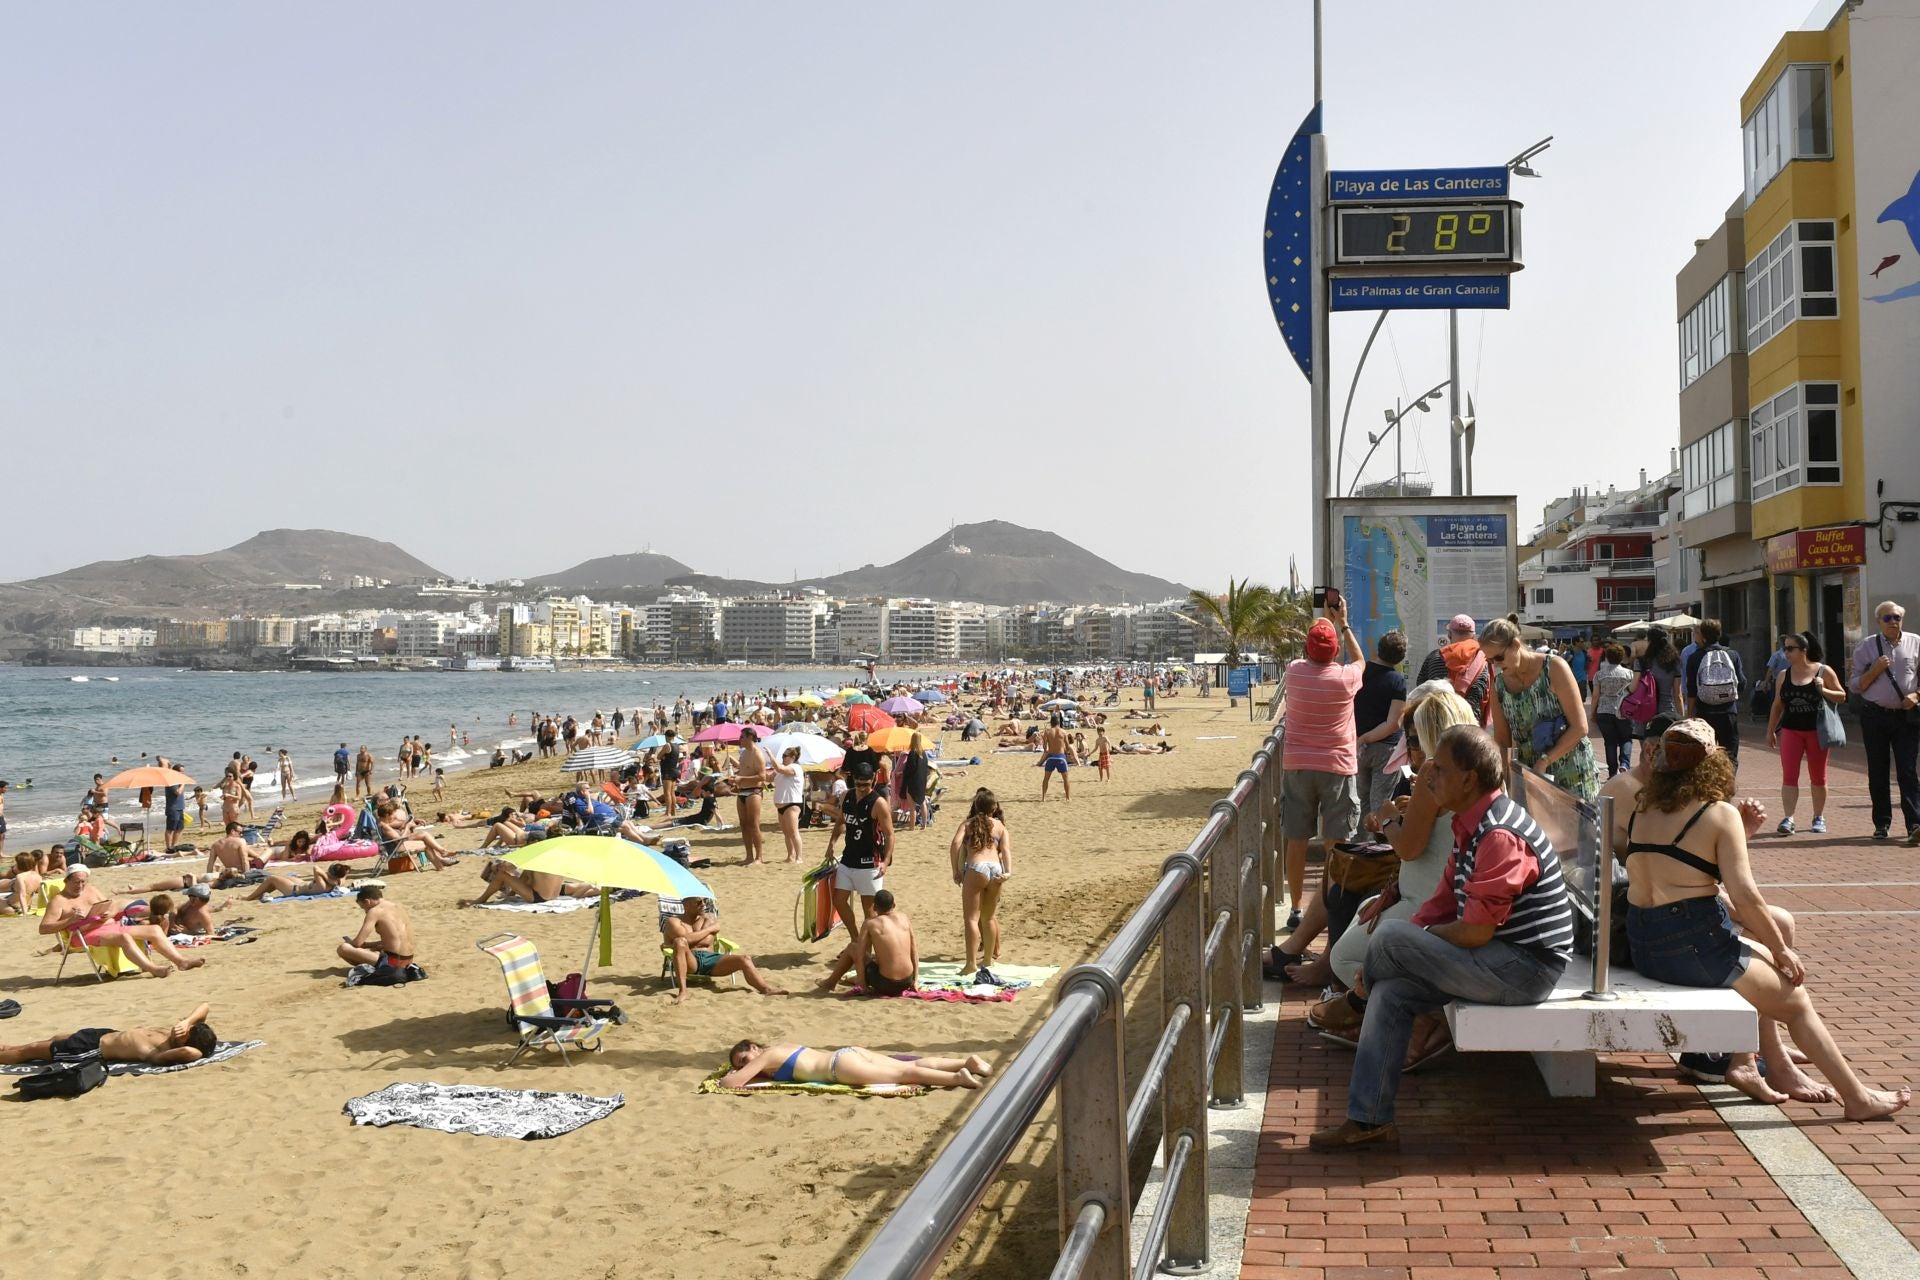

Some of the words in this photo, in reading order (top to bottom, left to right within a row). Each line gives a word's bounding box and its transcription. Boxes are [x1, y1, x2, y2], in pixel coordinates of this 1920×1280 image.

[1335, 180, 1375, 195] Playa
[1380, 179, 1399, 191] de
[1404, 178, 1429, 191] Las
[1434, 177, 1502, 190] Canteras
[1339, 286, 1358, 297] Las
[1361, 286, 1401, 296] Palmas
[1405, 286, 1420, 296] de
[1423, 285, 1452, 295] Gran
[1455, 284, 1500, 295] Canaria
[1450, 523, 1474, 532] Playa
[1476, 523, 1488, 531] de
[1440, 532, 1456, 540] Las
[1457, 531, 1498, 540] Canteras
[1815, 530, 1845, 543] Buffet
[1808, 544, 1829, 555] Casa
[1830, 542, 1854, 553] Chen
[853, 829, 862, 840] 3
